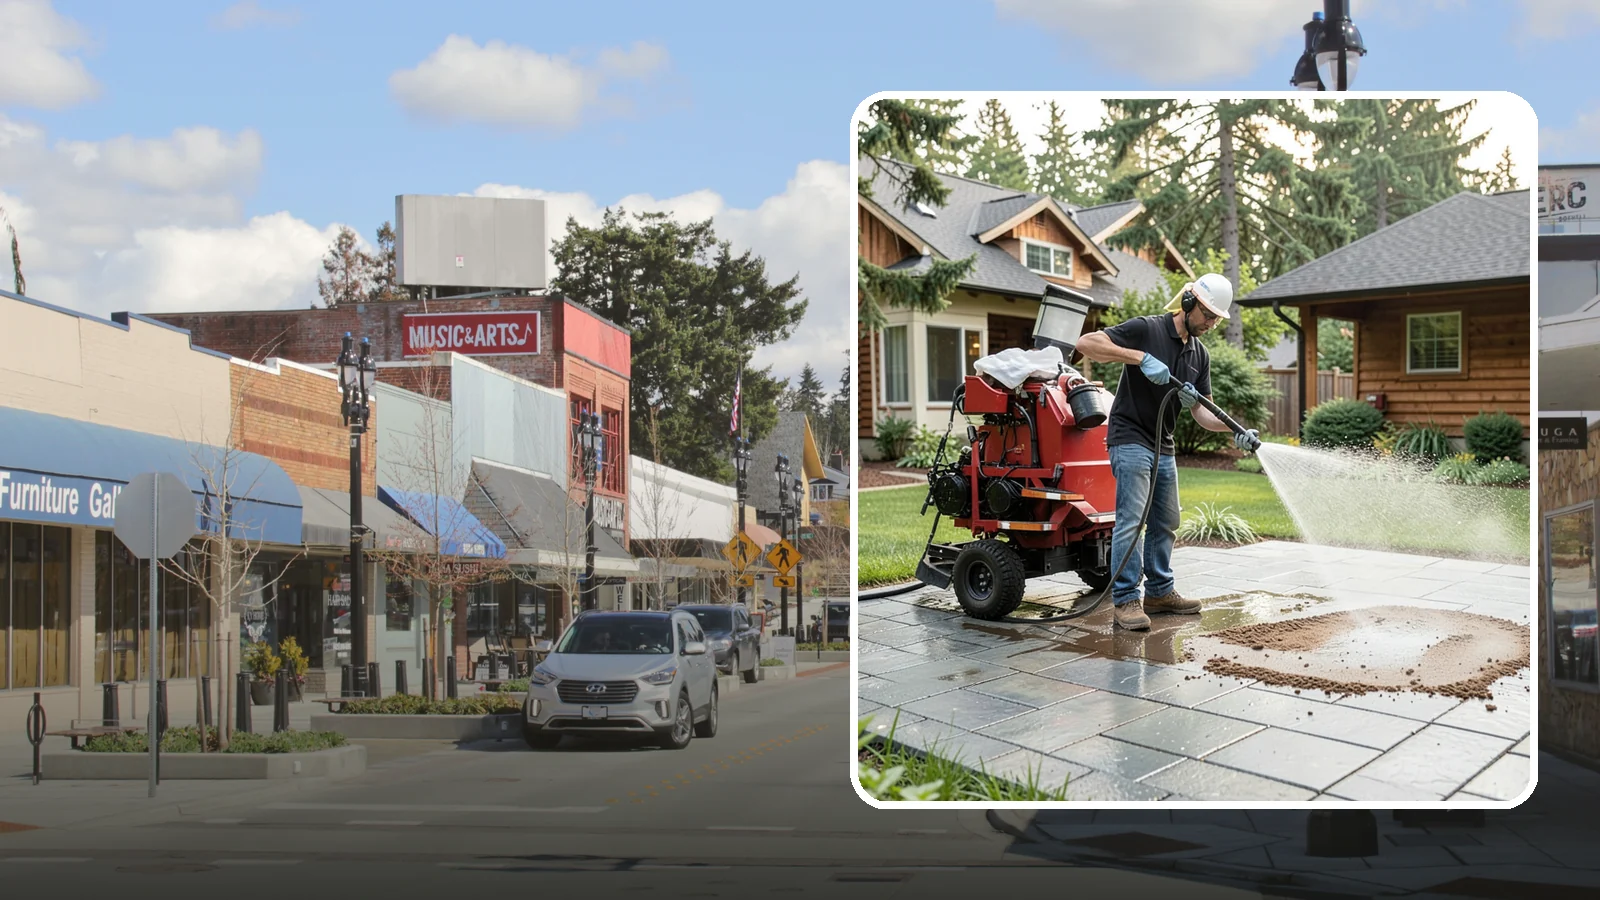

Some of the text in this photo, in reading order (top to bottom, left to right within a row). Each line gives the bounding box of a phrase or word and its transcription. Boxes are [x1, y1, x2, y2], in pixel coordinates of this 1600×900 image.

[408, 322, 520, 349] MUSIC&ARTS
[0, 472, 121, 519] Furniture Gal
[453, 563, 479, 574] SUSHI
